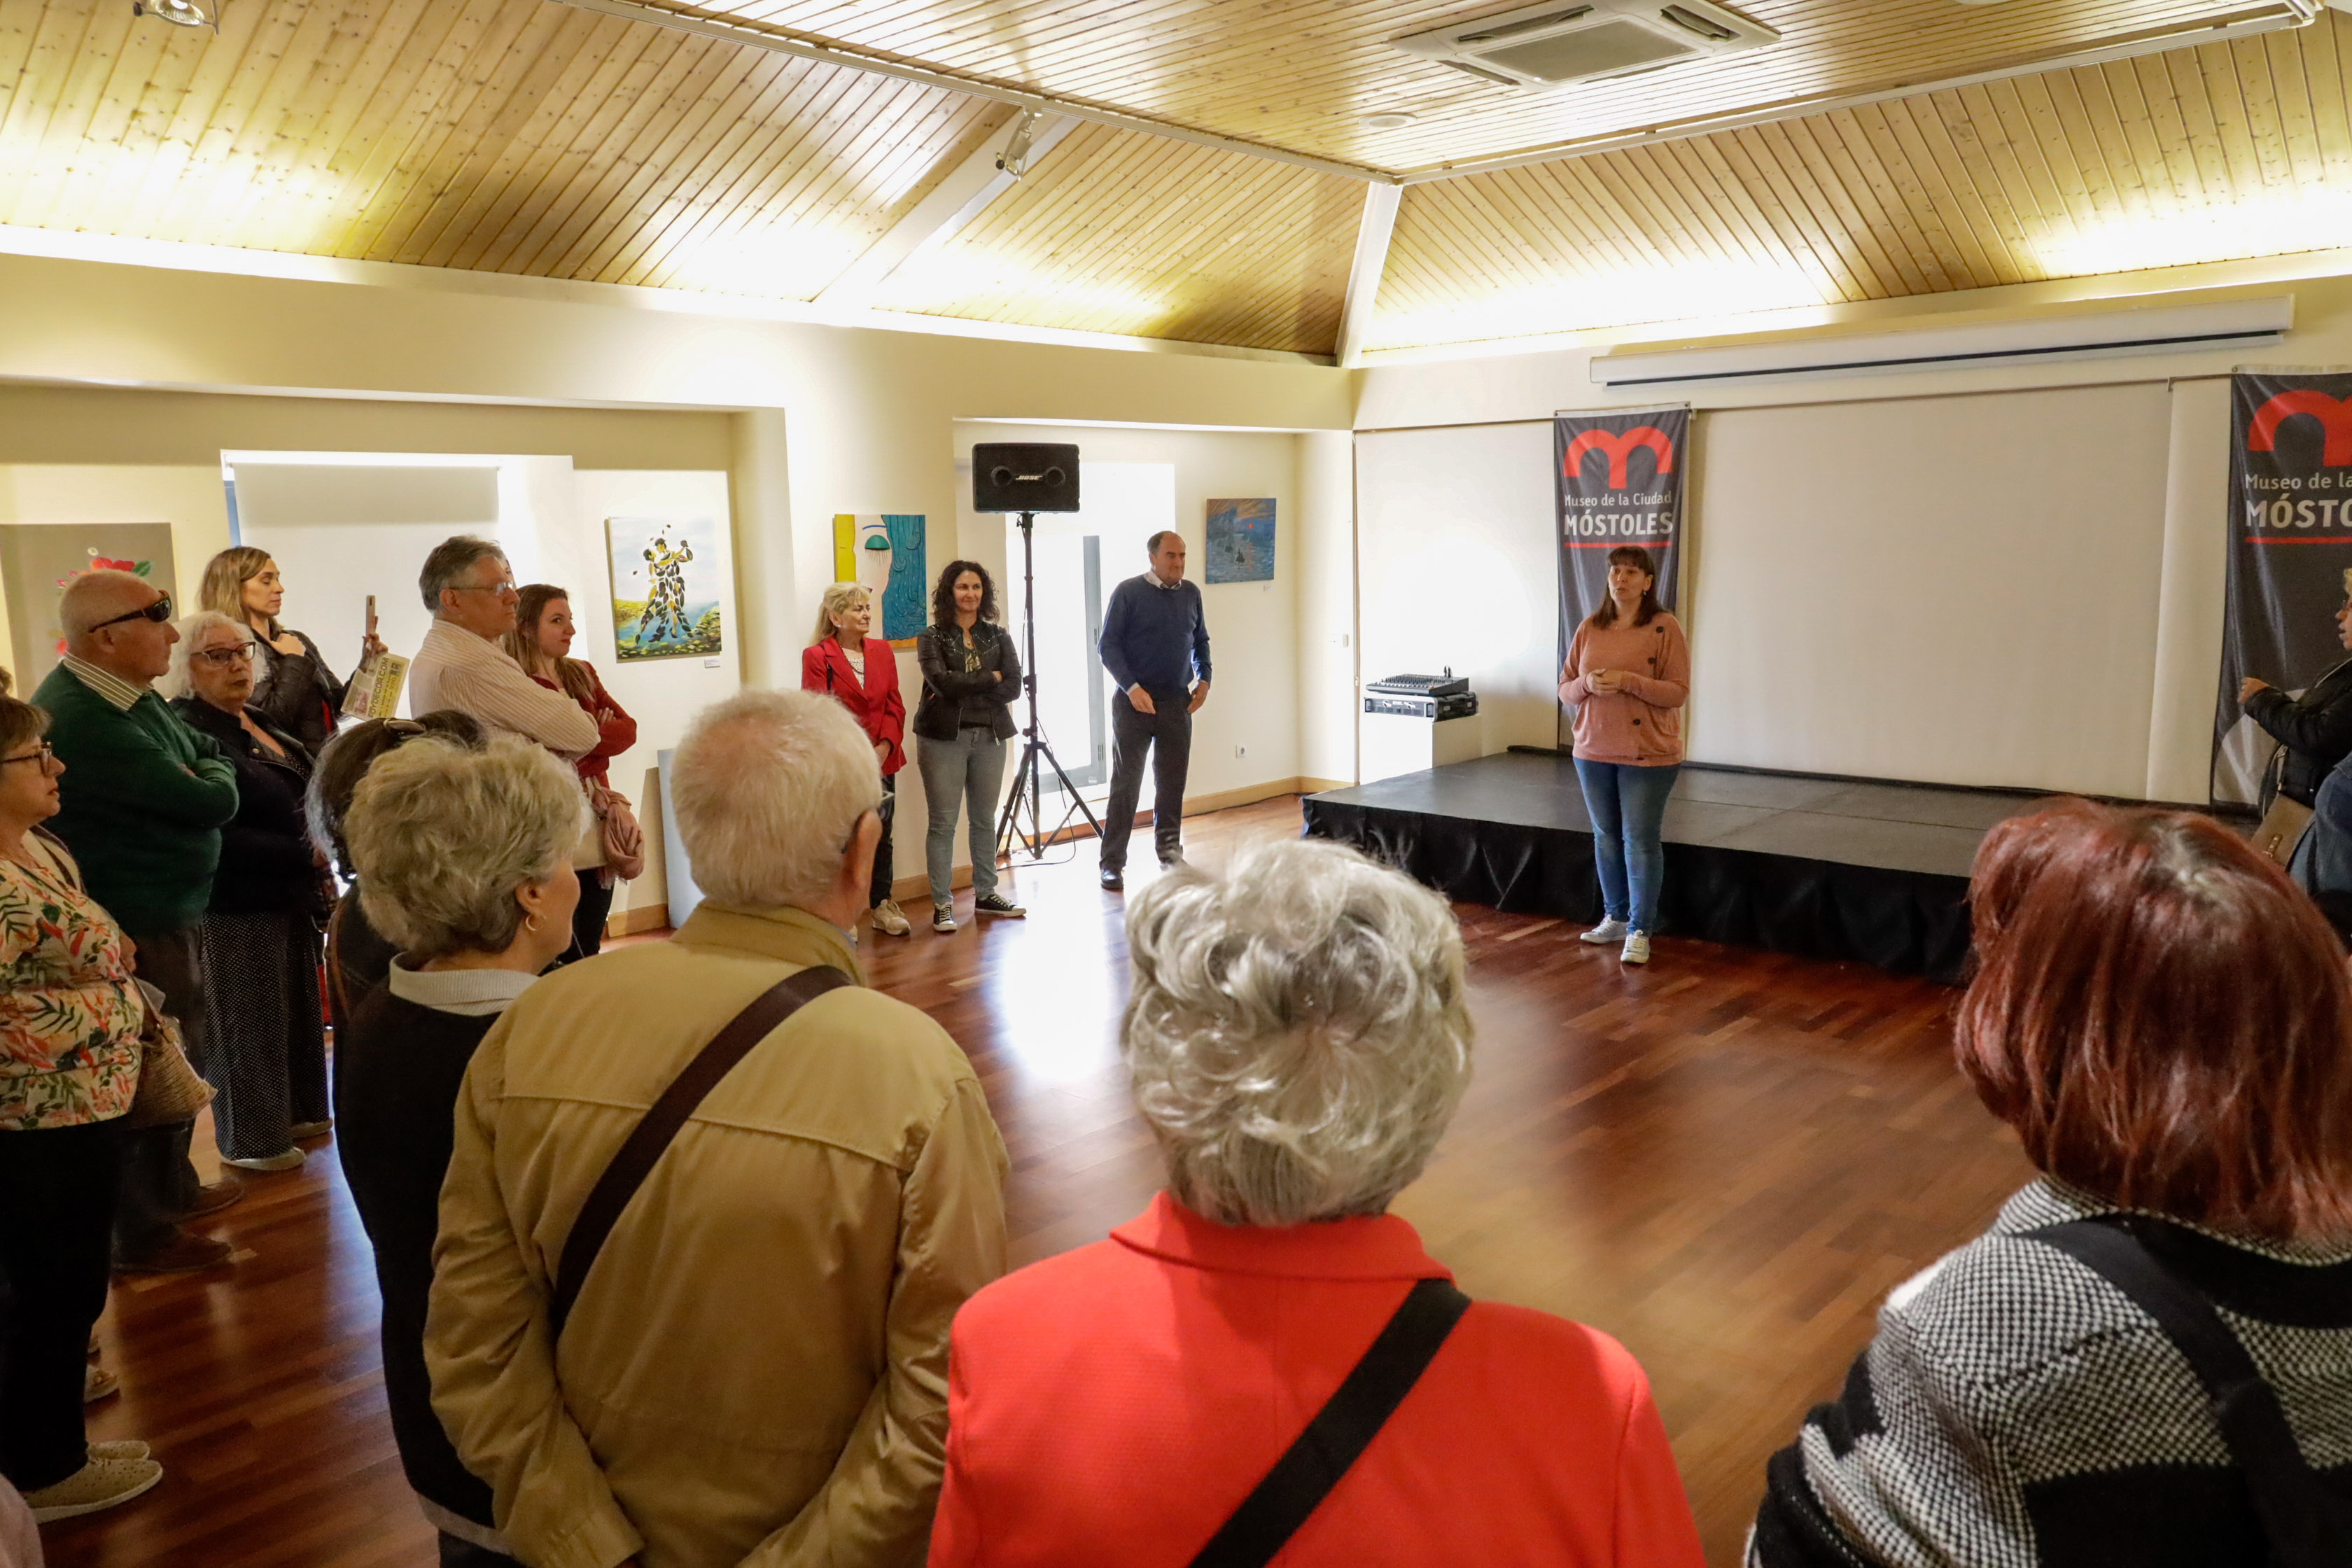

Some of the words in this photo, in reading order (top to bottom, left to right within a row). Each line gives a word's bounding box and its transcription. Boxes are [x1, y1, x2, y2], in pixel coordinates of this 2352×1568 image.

[2245, 473, 2302, 489] Museo
[2308, 472, 2332, 489] de
[1564, 493, 1597, 506] Museo
[1601, 493, 1615, 506] de
[1618, 493, 1630, 505] la
[1633, 491, 1672, 505] Ciudad
[1564, 509, 1673, 536] MÓSTOLES
